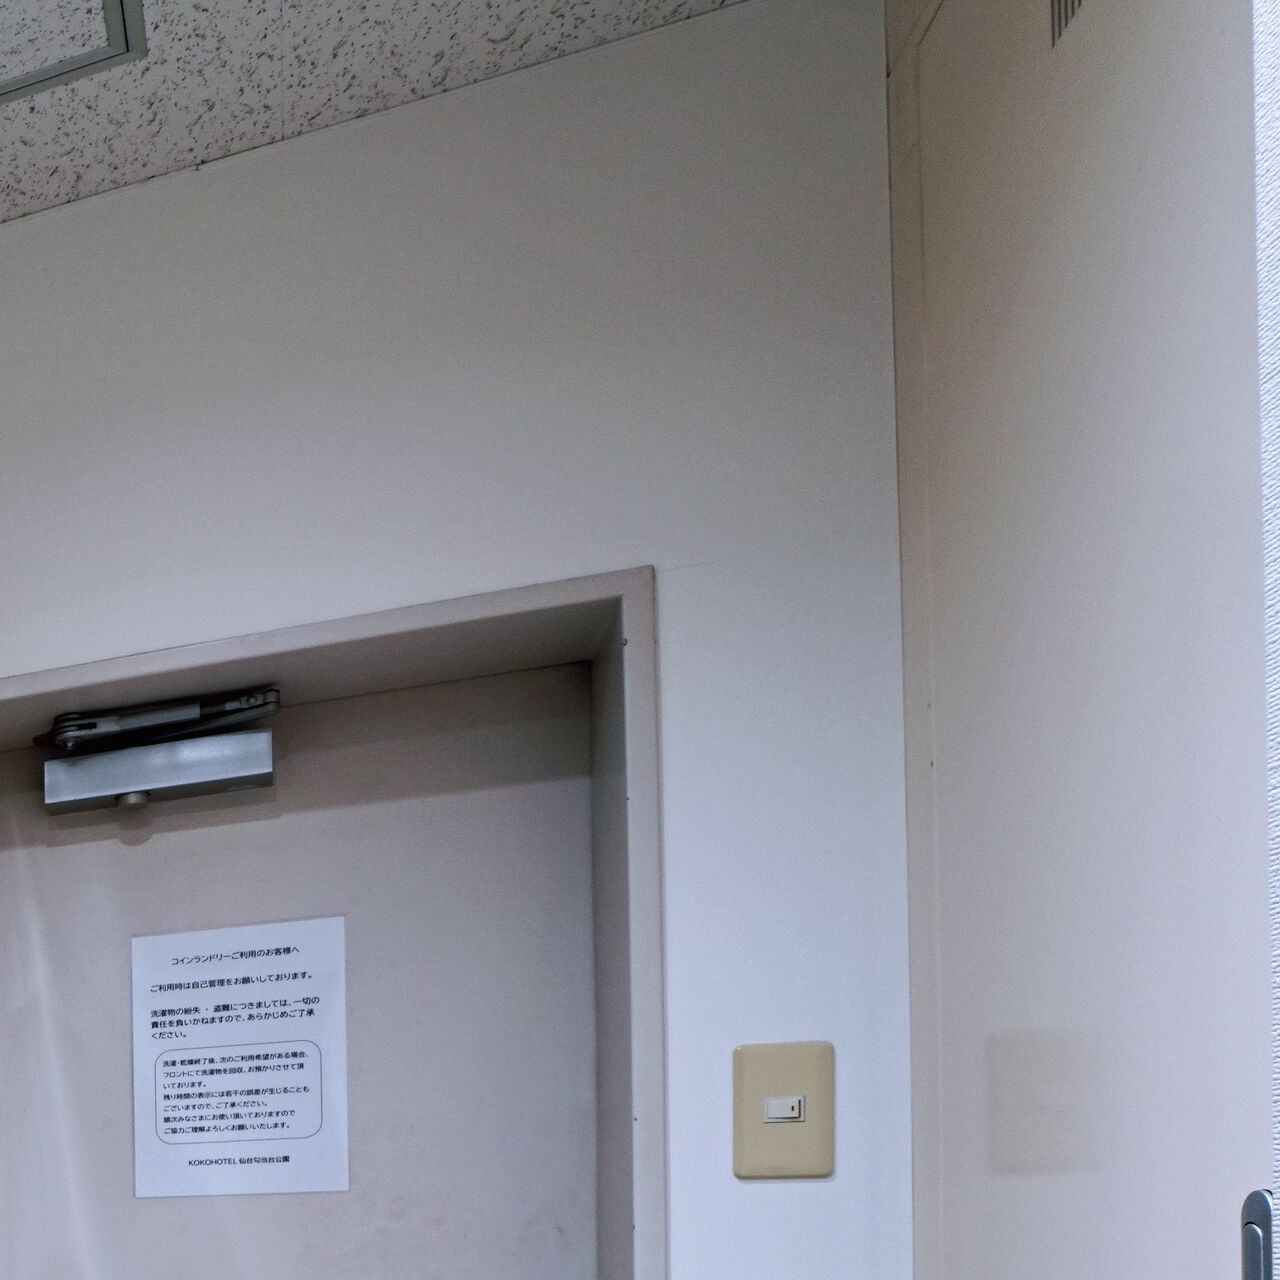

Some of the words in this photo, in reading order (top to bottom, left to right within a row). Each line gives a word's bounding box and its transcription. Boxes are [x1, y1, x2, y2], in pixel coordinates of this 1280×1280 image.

[171, 946, 300, 965] コインランドリーご利用のお客様へ
[150, 971, 312, 992] ご利用時は自己管理をお願いしております。
[151, 1008, 315, 1029] 責任を負いかねますので、あらかじめご了承
[151, 1031, 187, 1040] ください。
[163, 1081, 207, 1089] いております。
[163, 1100, 268, 1112] ございますので、ご了承ください。
[188, 1158, 237, 1167] KOKOHOTEL
